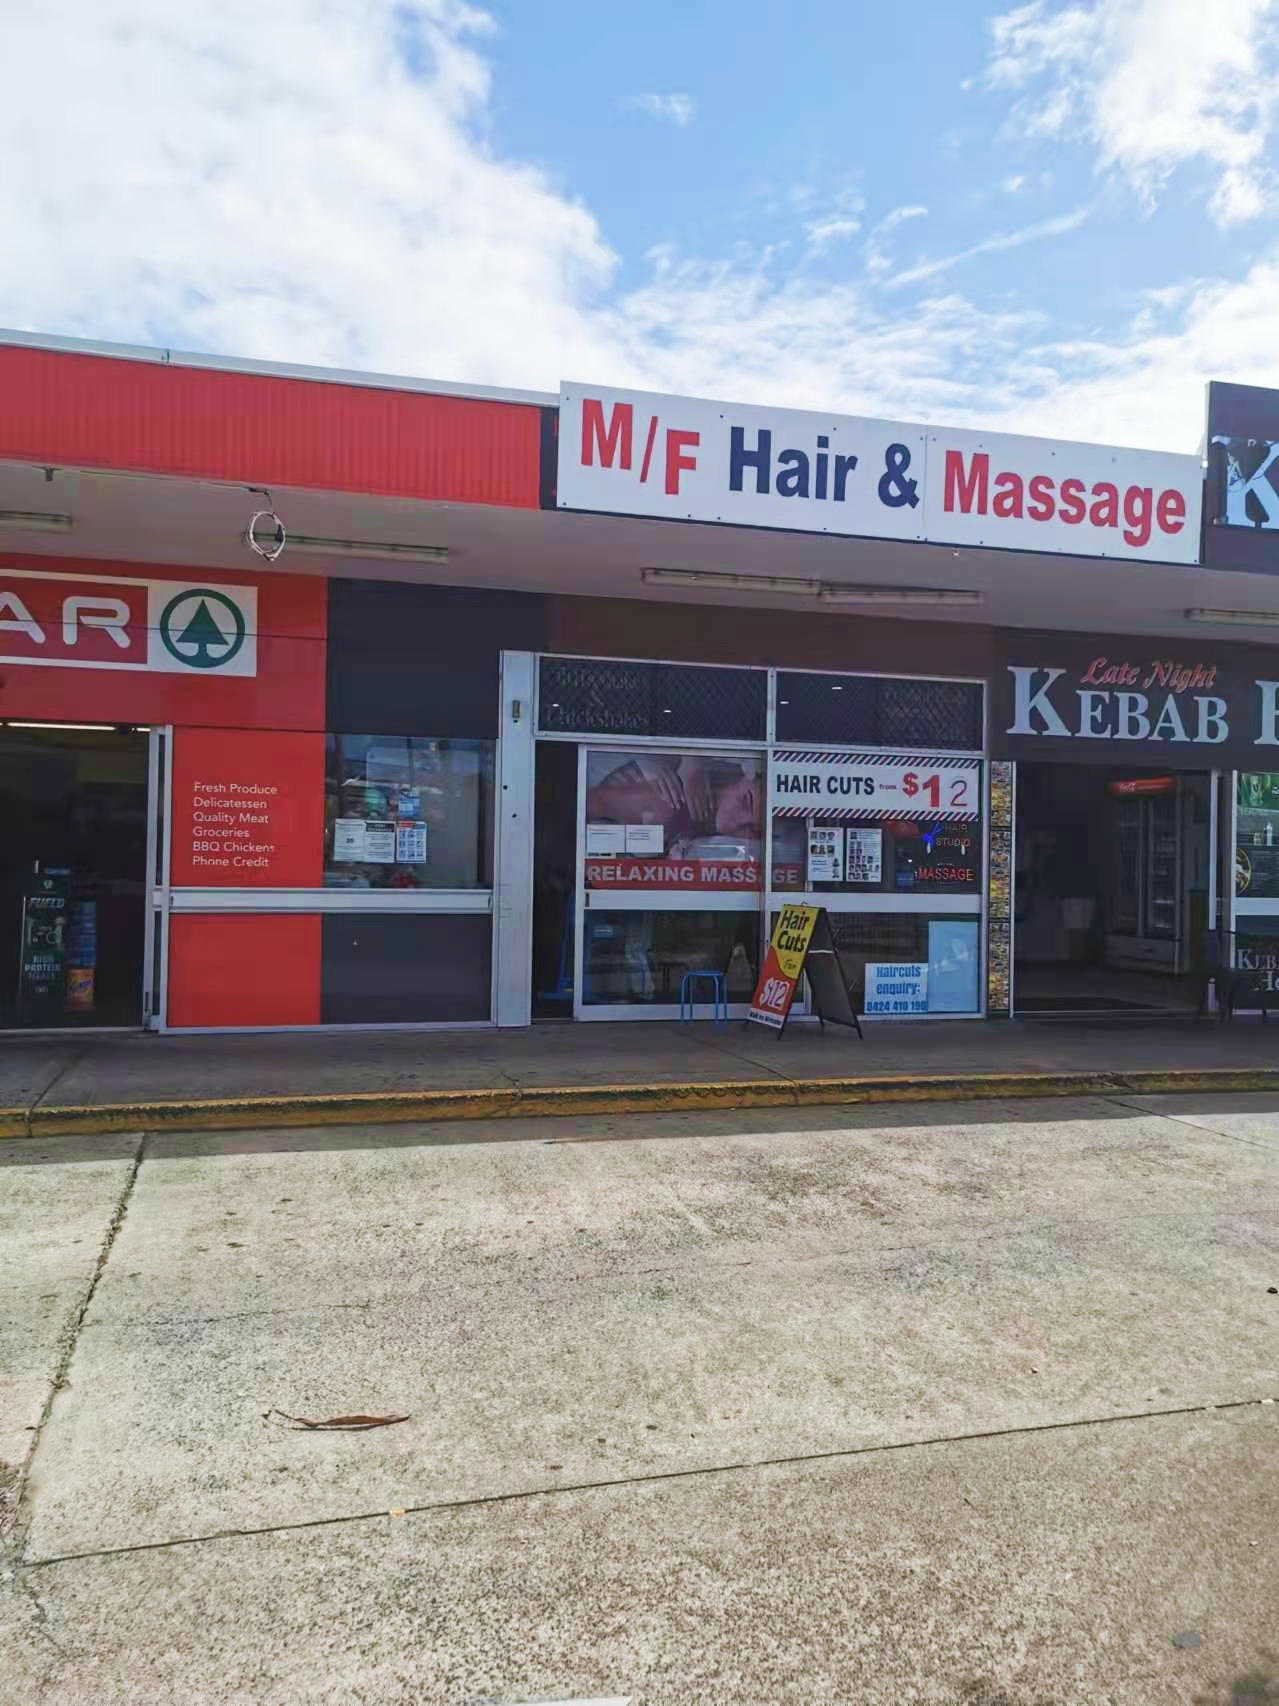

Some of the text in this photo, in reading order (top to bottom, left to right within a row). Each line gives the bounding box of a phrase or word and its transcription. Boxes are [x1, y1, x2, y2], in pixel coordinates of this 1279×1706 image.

[581, 398, 1186, 547] M/F Hair & Massage
[1080, 657, 1217, 694] Late Night
[1005, 665, 1229, 743] KEBAB
[193, 781, 278, 795] Fresh Produce
[776, 774, 821, 794] HAIR
[827, 776, 875, 796] CUTS
[193, 796, 267, 809] Delicatessen
[193, 811, 269, 825] Quality Meat
[192, 826, 250, 838] Groceries
[192, 840, 220, 852] BBQ
[192, 855, 269, 868] Phone Credit
[587, 864, 800, 885] RELAXING MASSGE
[918, 867, 975, 881] MASSAGE
[780, 910, 809, 931] Hair
[777, 930, 808, 953] Cuts
[760, 978, 789, 1008] $12
